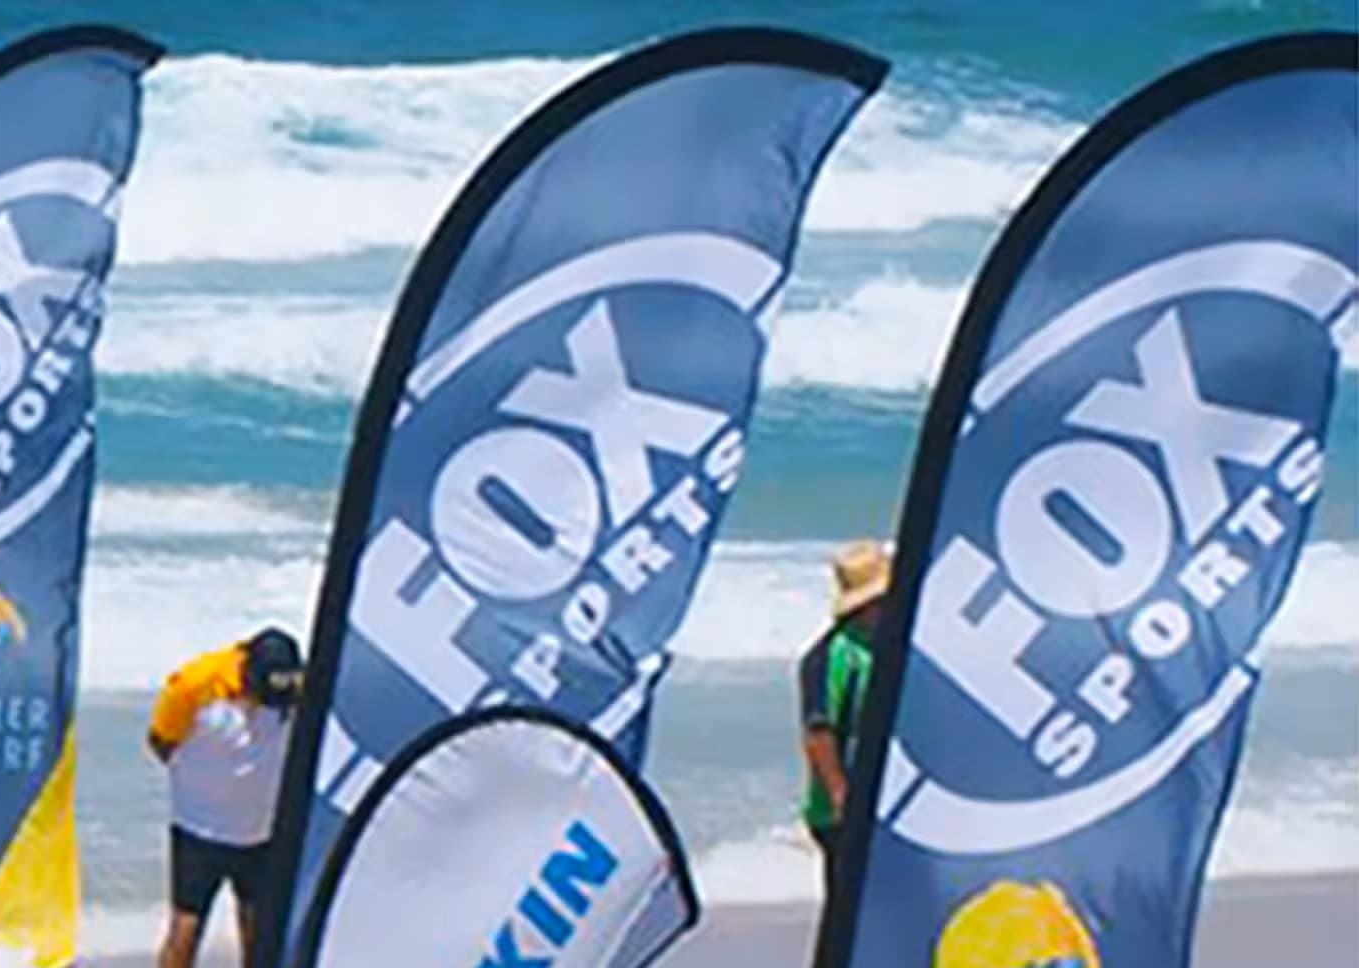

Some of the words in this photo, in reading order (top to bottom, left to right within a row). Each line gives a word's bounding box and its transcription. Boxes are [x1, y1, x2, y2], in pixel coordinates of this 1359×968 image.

[349, 298, 731, 714] FOX
[477, 430, 744, 708] PORTS
[912, 307, 1303, 742] FOX
[1035, 439, 1325, 779] SPORTS
